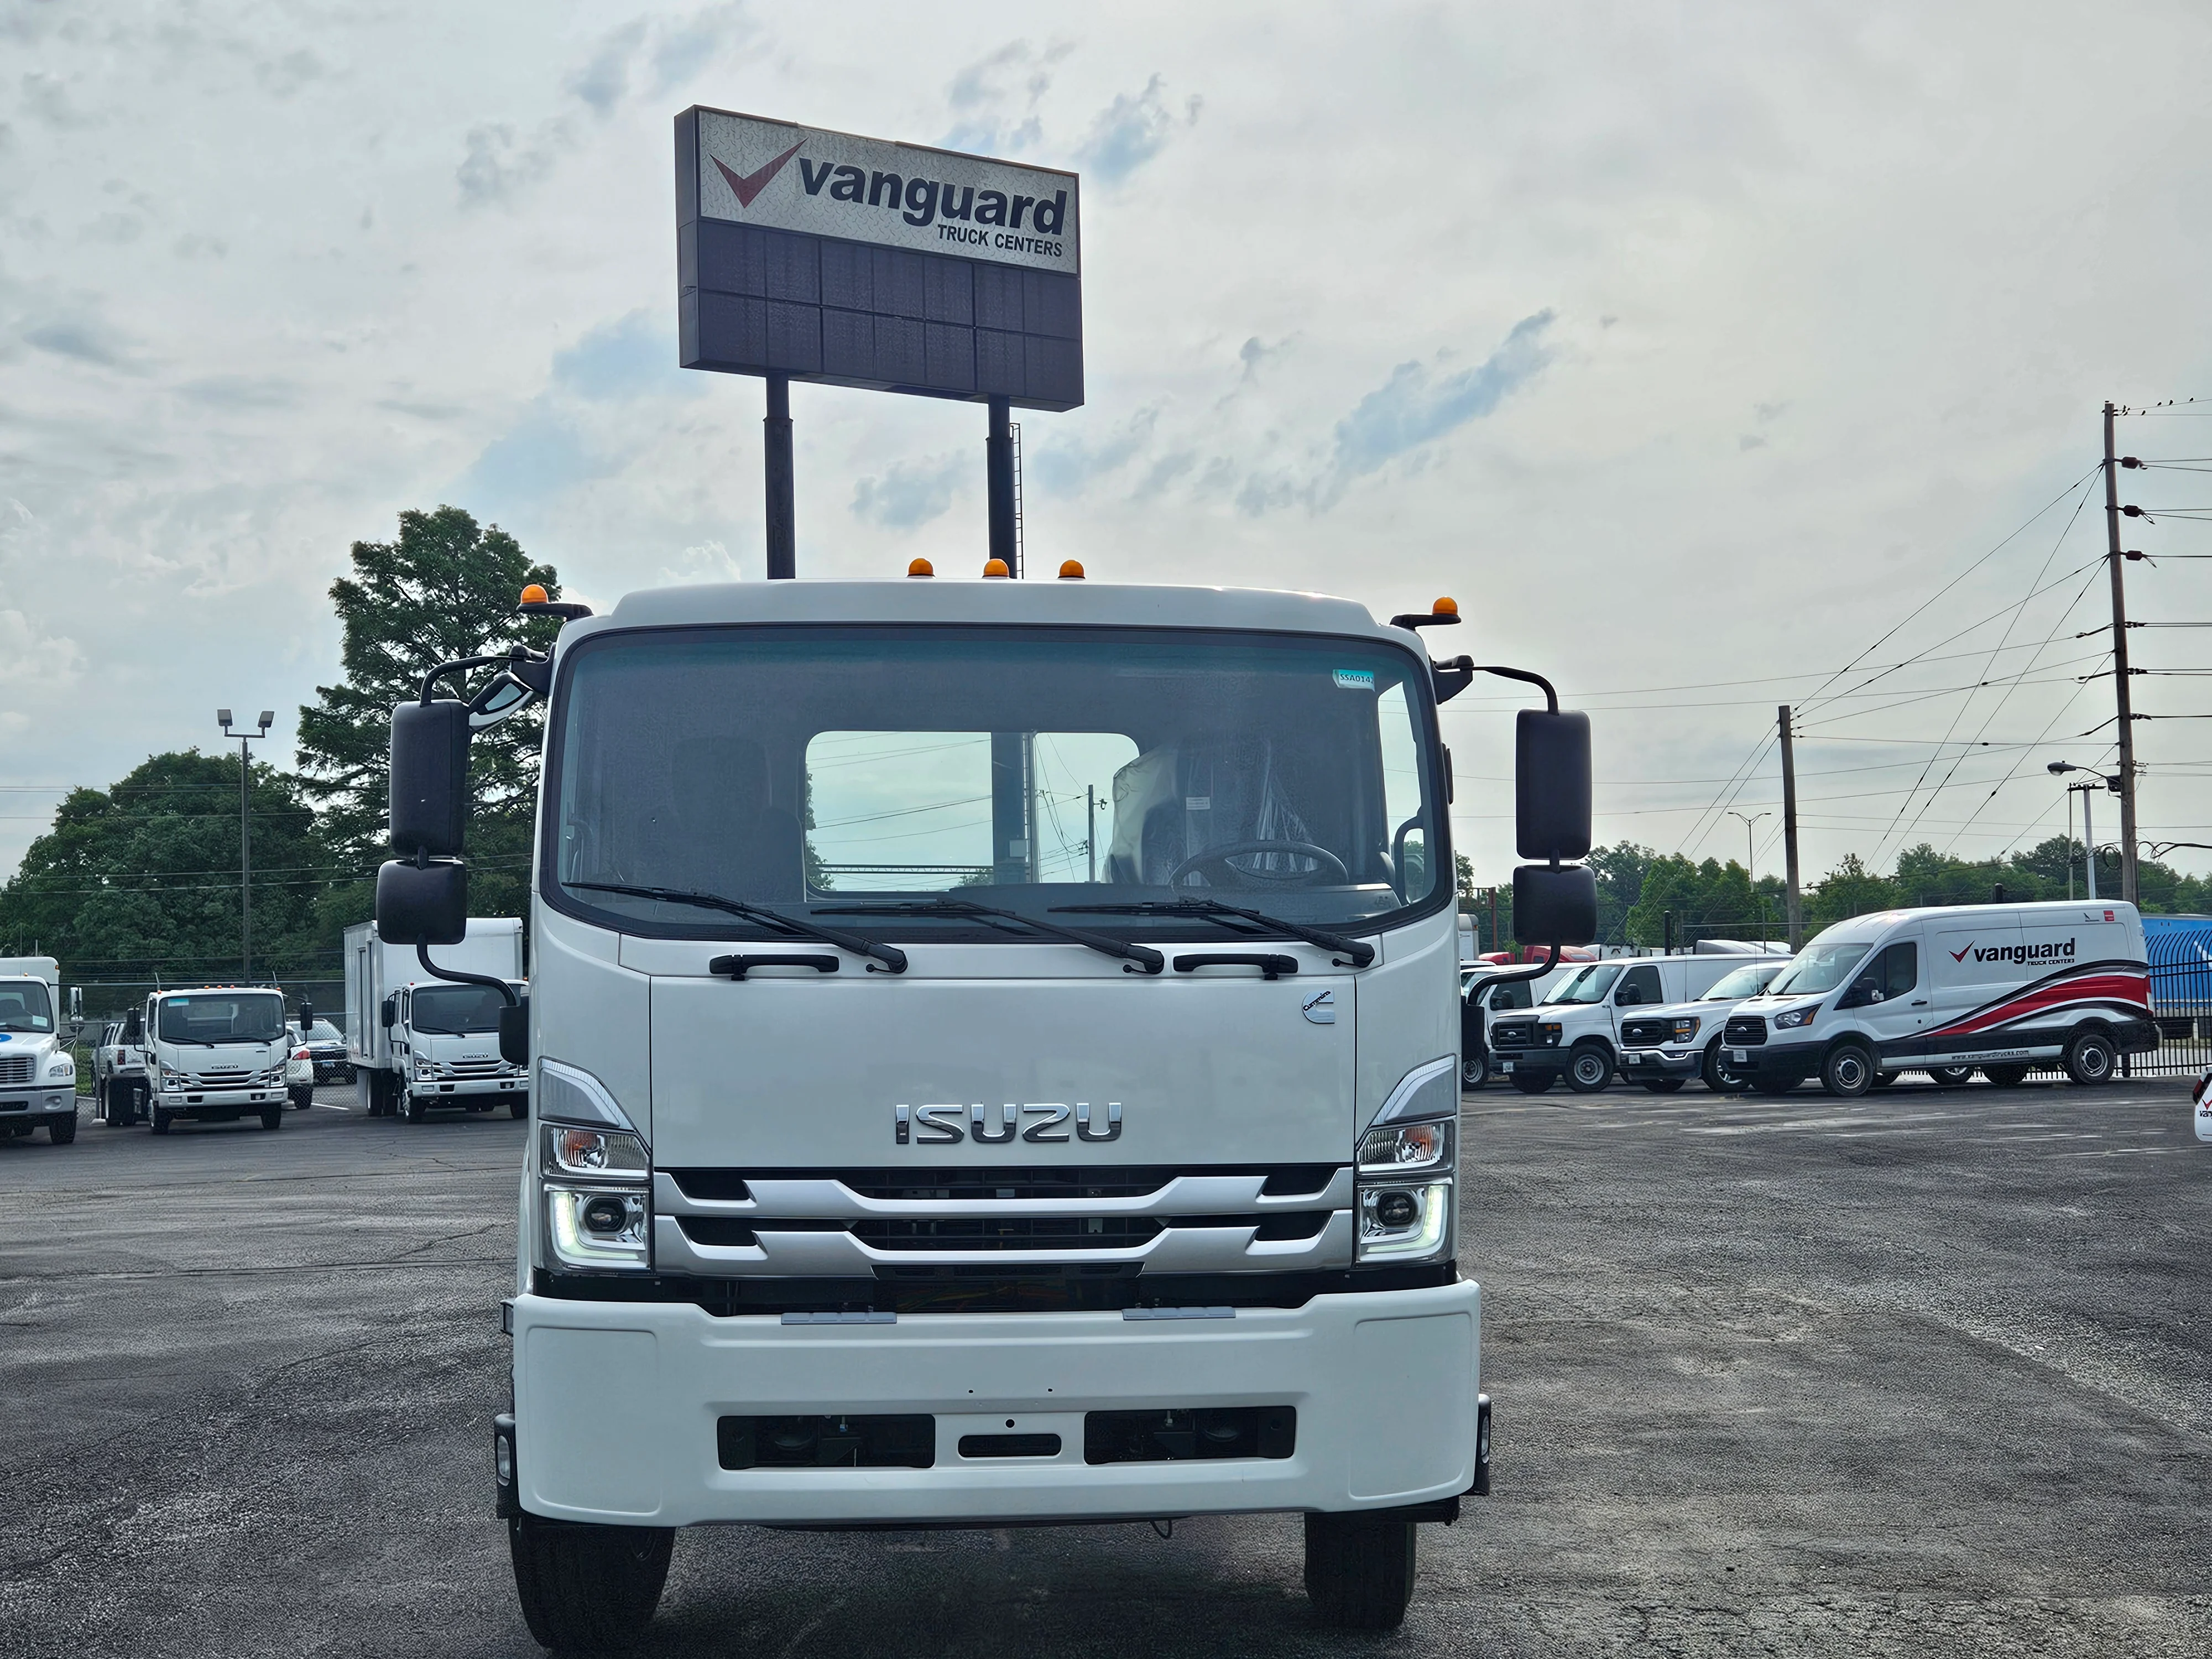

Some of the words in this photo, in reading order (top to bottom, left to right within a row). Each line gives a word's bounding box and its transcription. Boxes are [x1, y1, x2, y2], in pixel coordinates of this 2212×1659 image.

[799, 158, 1067, 236] vanguard
[937, 223, 989, 247] TRUCK
[995, 233, 1063, 257] CENTERS
[1974, 937, 2075, 964] vanguard
[895, 1102, 1122, 1144] ISUZU
